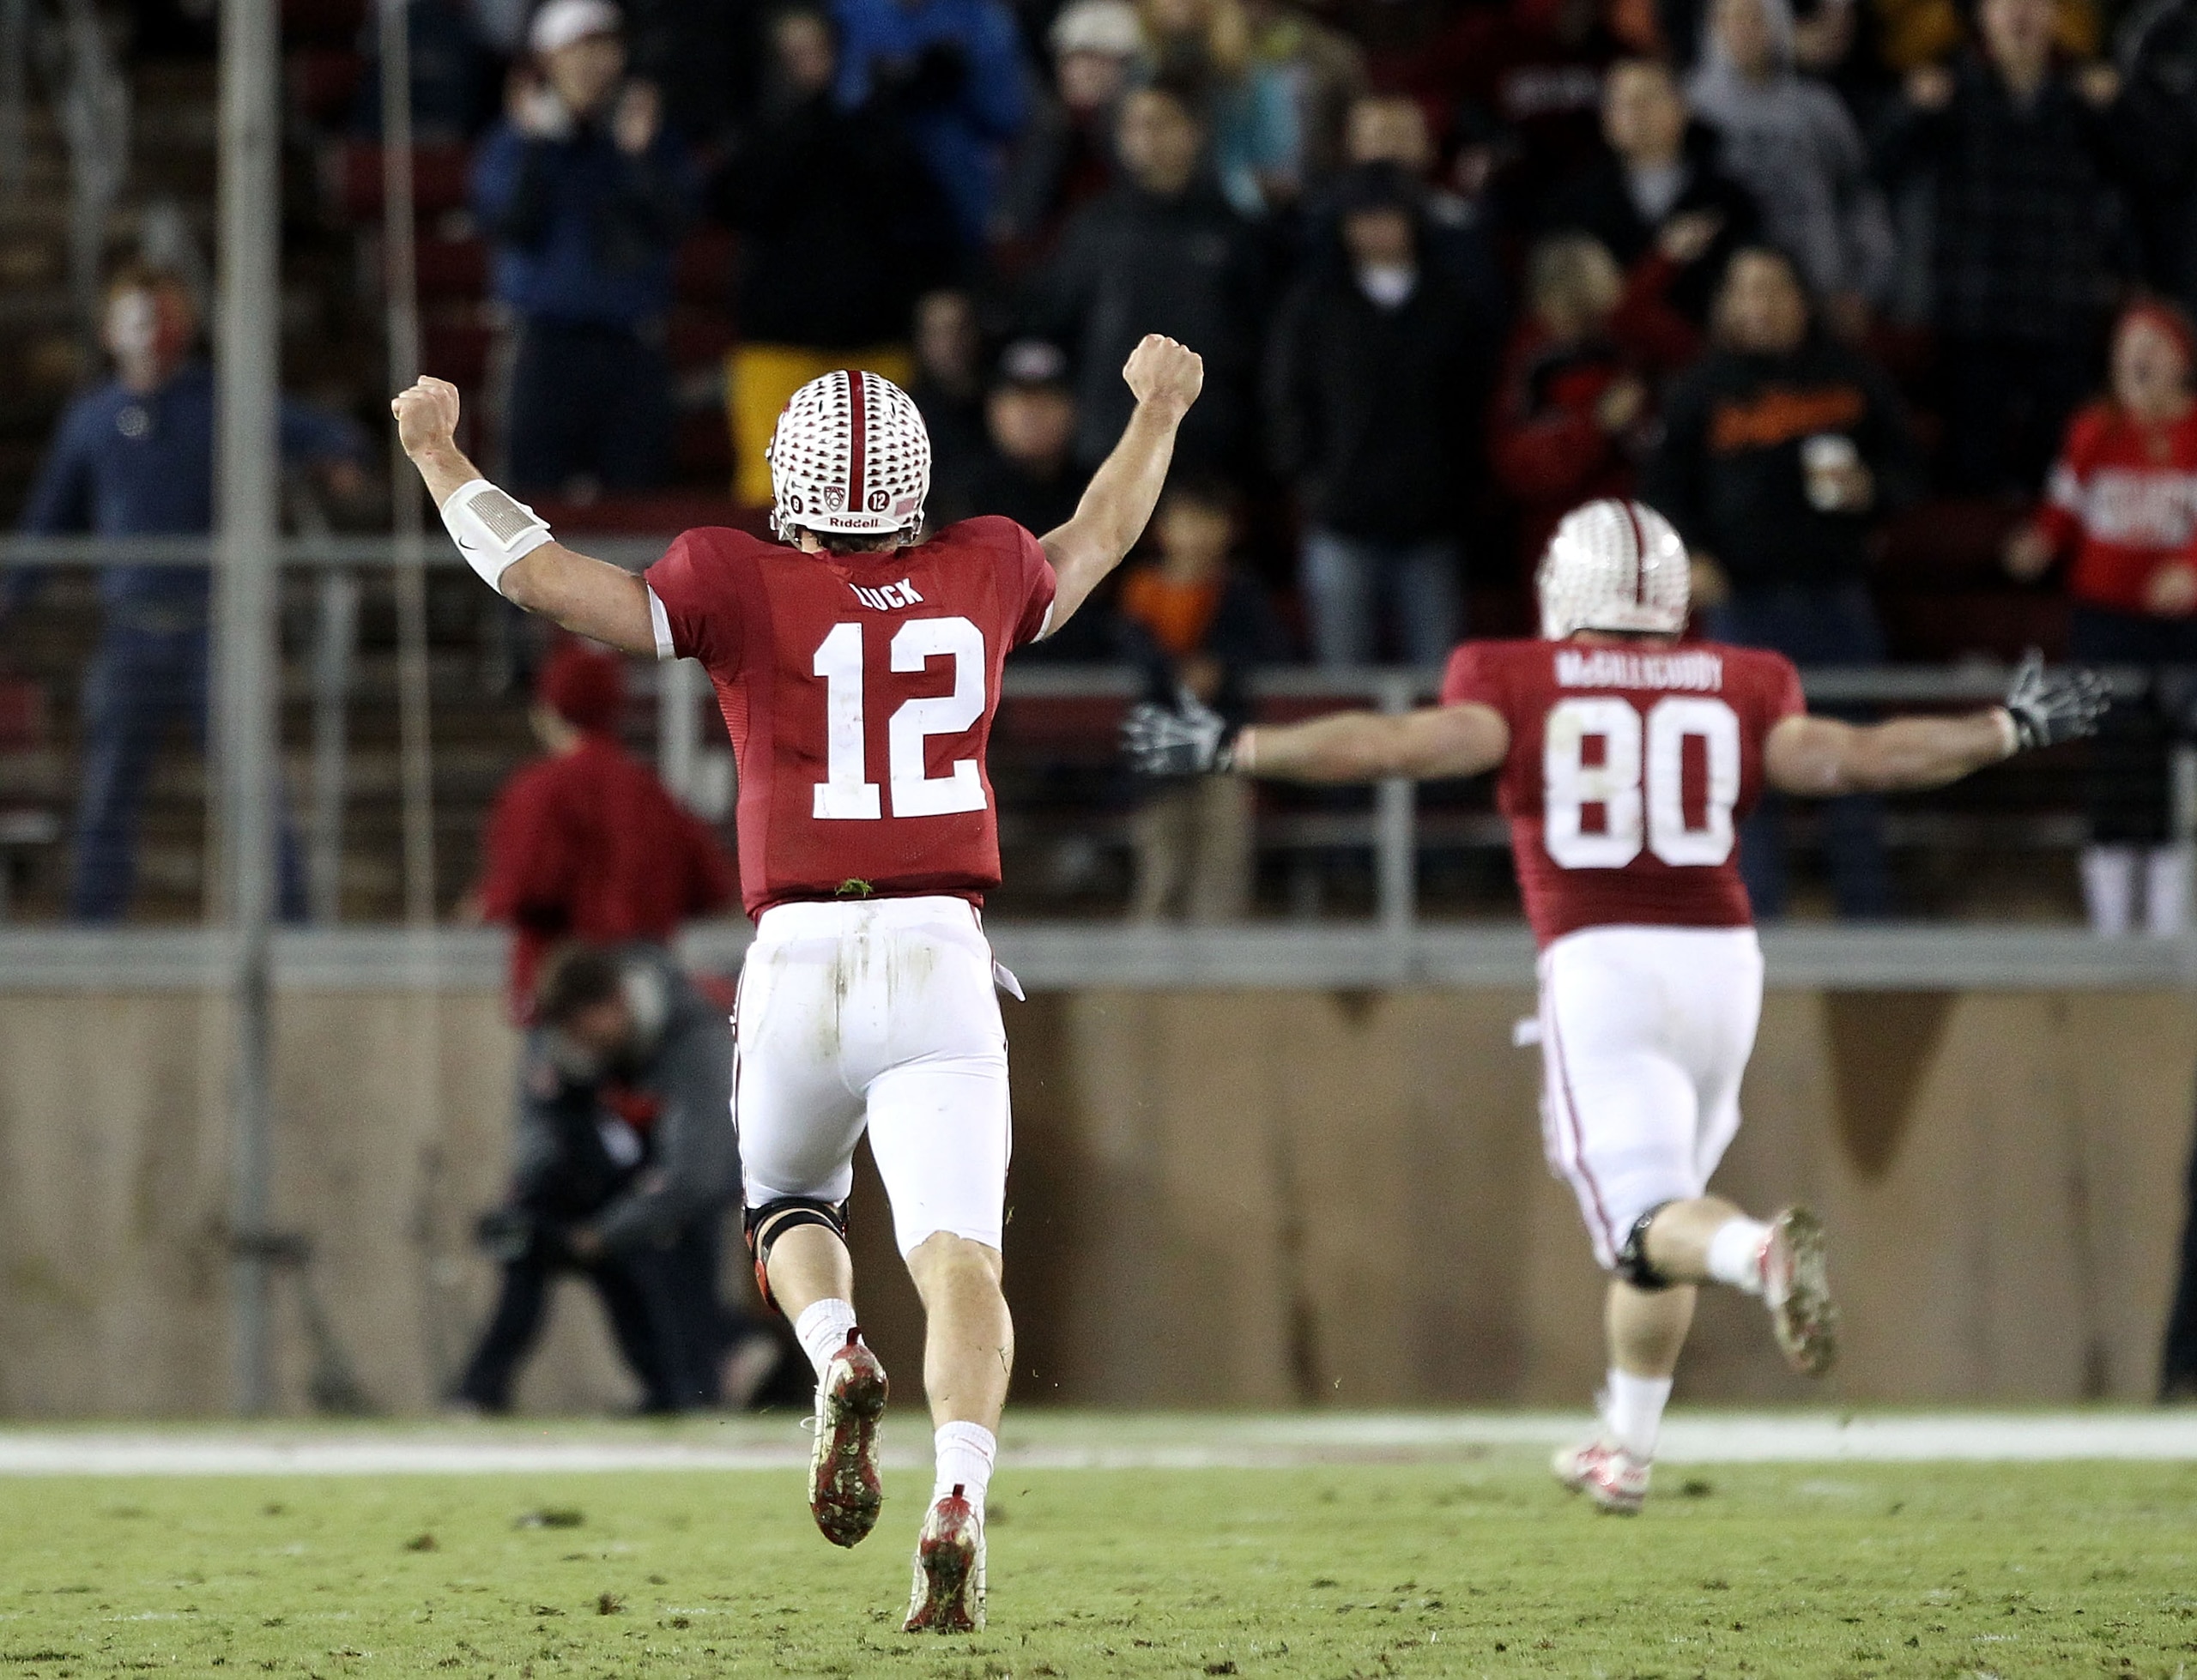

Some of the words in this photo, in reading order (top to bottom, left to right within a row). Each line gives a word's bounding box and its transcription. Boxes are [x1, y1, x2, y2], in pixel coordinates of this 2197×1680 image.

[872, 493, 886, 510] 12
[829, 518, 879, 529] Riddell
[848, 577, 924, 611] LUCK
[813, 616, 988, 819] 12
[1544, 696, 1740, 868] 80
